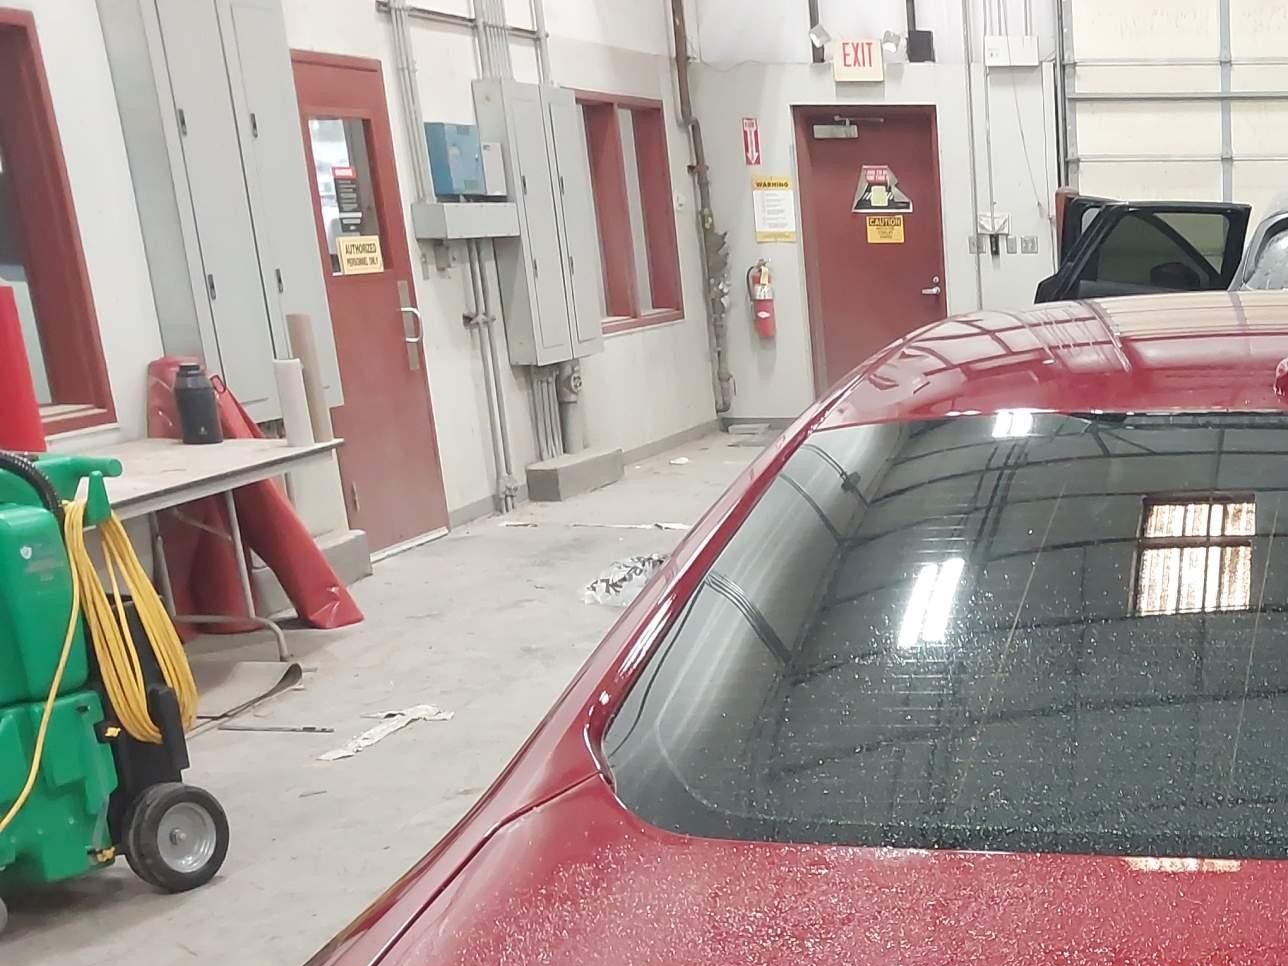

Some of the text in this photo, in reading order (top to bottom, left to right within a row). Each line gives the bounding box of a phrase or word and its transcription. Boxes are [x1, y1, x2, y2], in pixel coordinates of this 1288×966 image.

[842, 42, 872, 67] EXIT
[869, 218, 901, 226] CAUTION
[345, 243, 377, 255] AUTHORIZED
